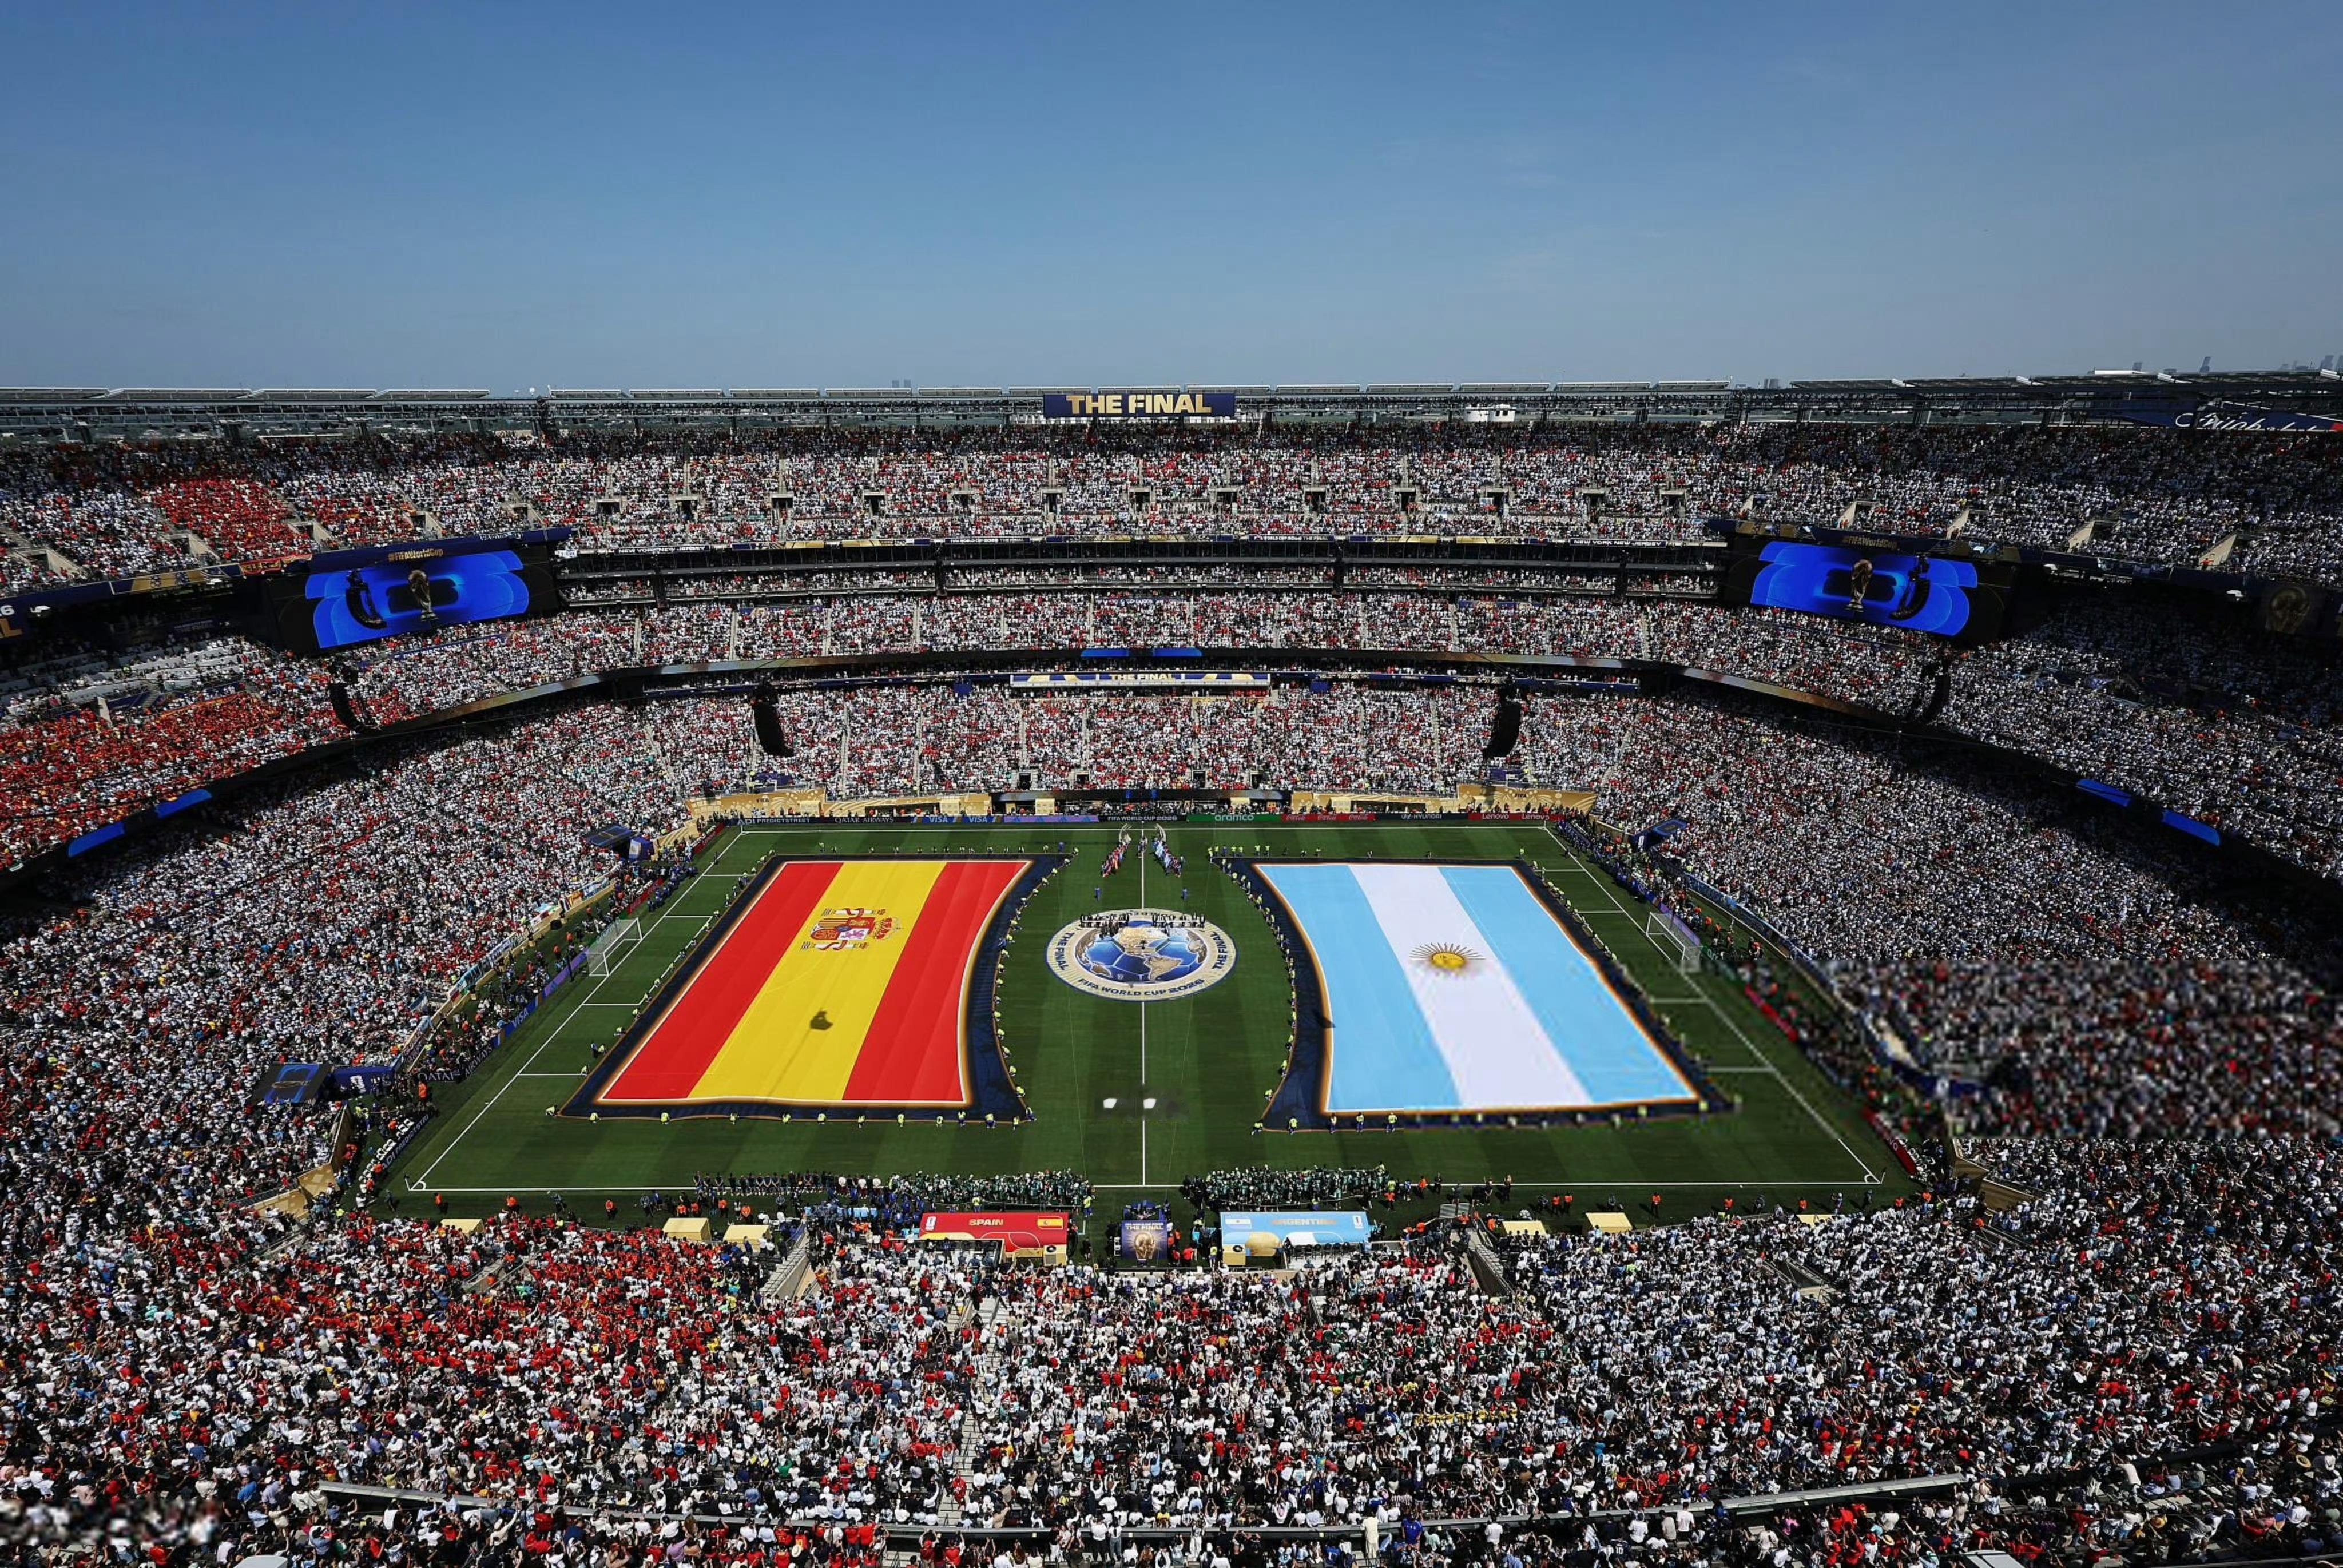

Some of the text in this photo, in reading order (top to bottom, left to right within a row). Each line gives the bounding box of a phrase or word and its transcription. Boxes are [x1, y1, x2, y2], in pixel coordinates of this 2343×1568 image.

[1066, 394, 1212, 414] THE FINAL
[1054, 932, 1075, 970] THE FINAL
[1210, 932, 1228, 970] THE FINAL
[1078, 978, 1099, 990] FIFA
[1101, 986, 1142, 996] WORLD
[1165, 978, 1205, 993] 2026
[510, 1007, 529, 1028] VISA
